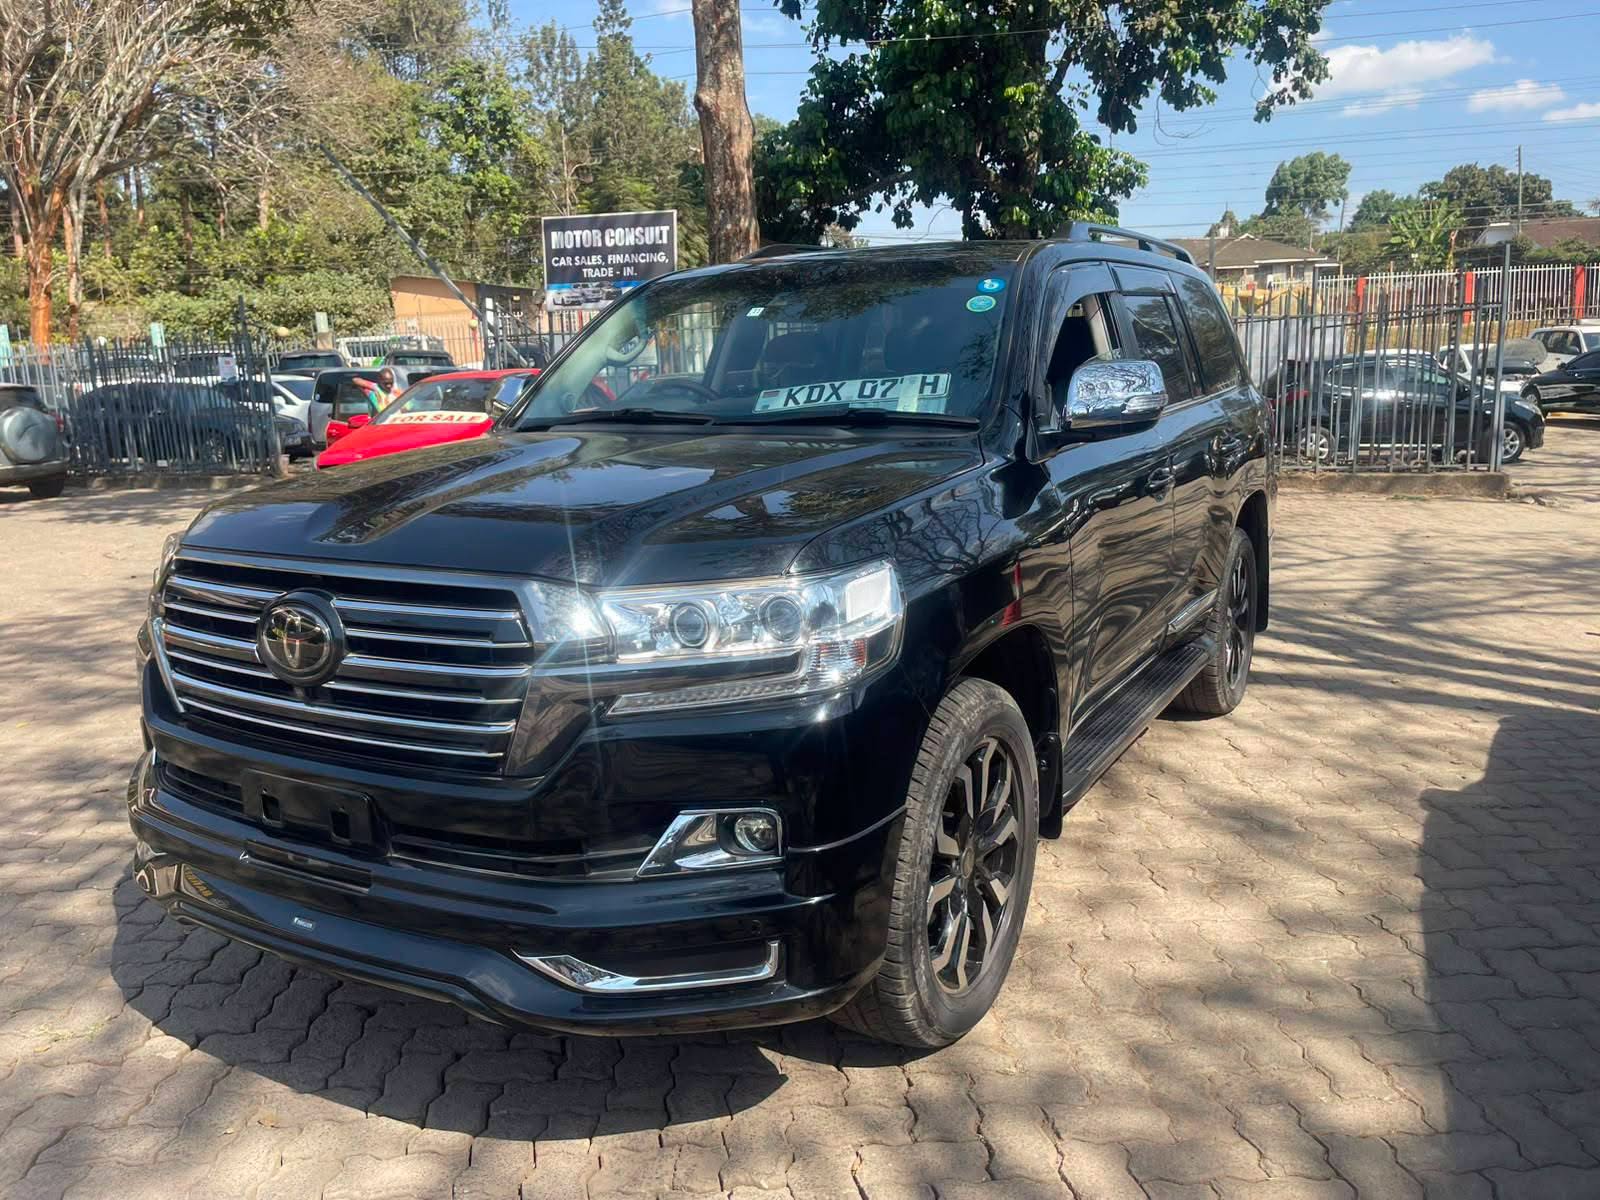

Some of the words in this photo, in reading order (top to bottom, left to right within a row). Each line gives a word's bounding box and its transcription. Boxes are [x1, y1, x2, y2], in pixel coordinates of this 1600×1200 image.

[550, 229, 602, 249] MOTOR
[604, 225, 670, 247] CONSULT
[551, 257, 573, 267] CAR
[574, 255, 606, 266] SALES,
[607, 252, 669, 264] FINANCING,
[582, 268, 614, 278] TRADE
[623, 266, 638, 277] IN.
[783, 381, 846, 407] KDX
[391, 415, 427, 423] FOR
[430, 414, 482, 422] SALE
